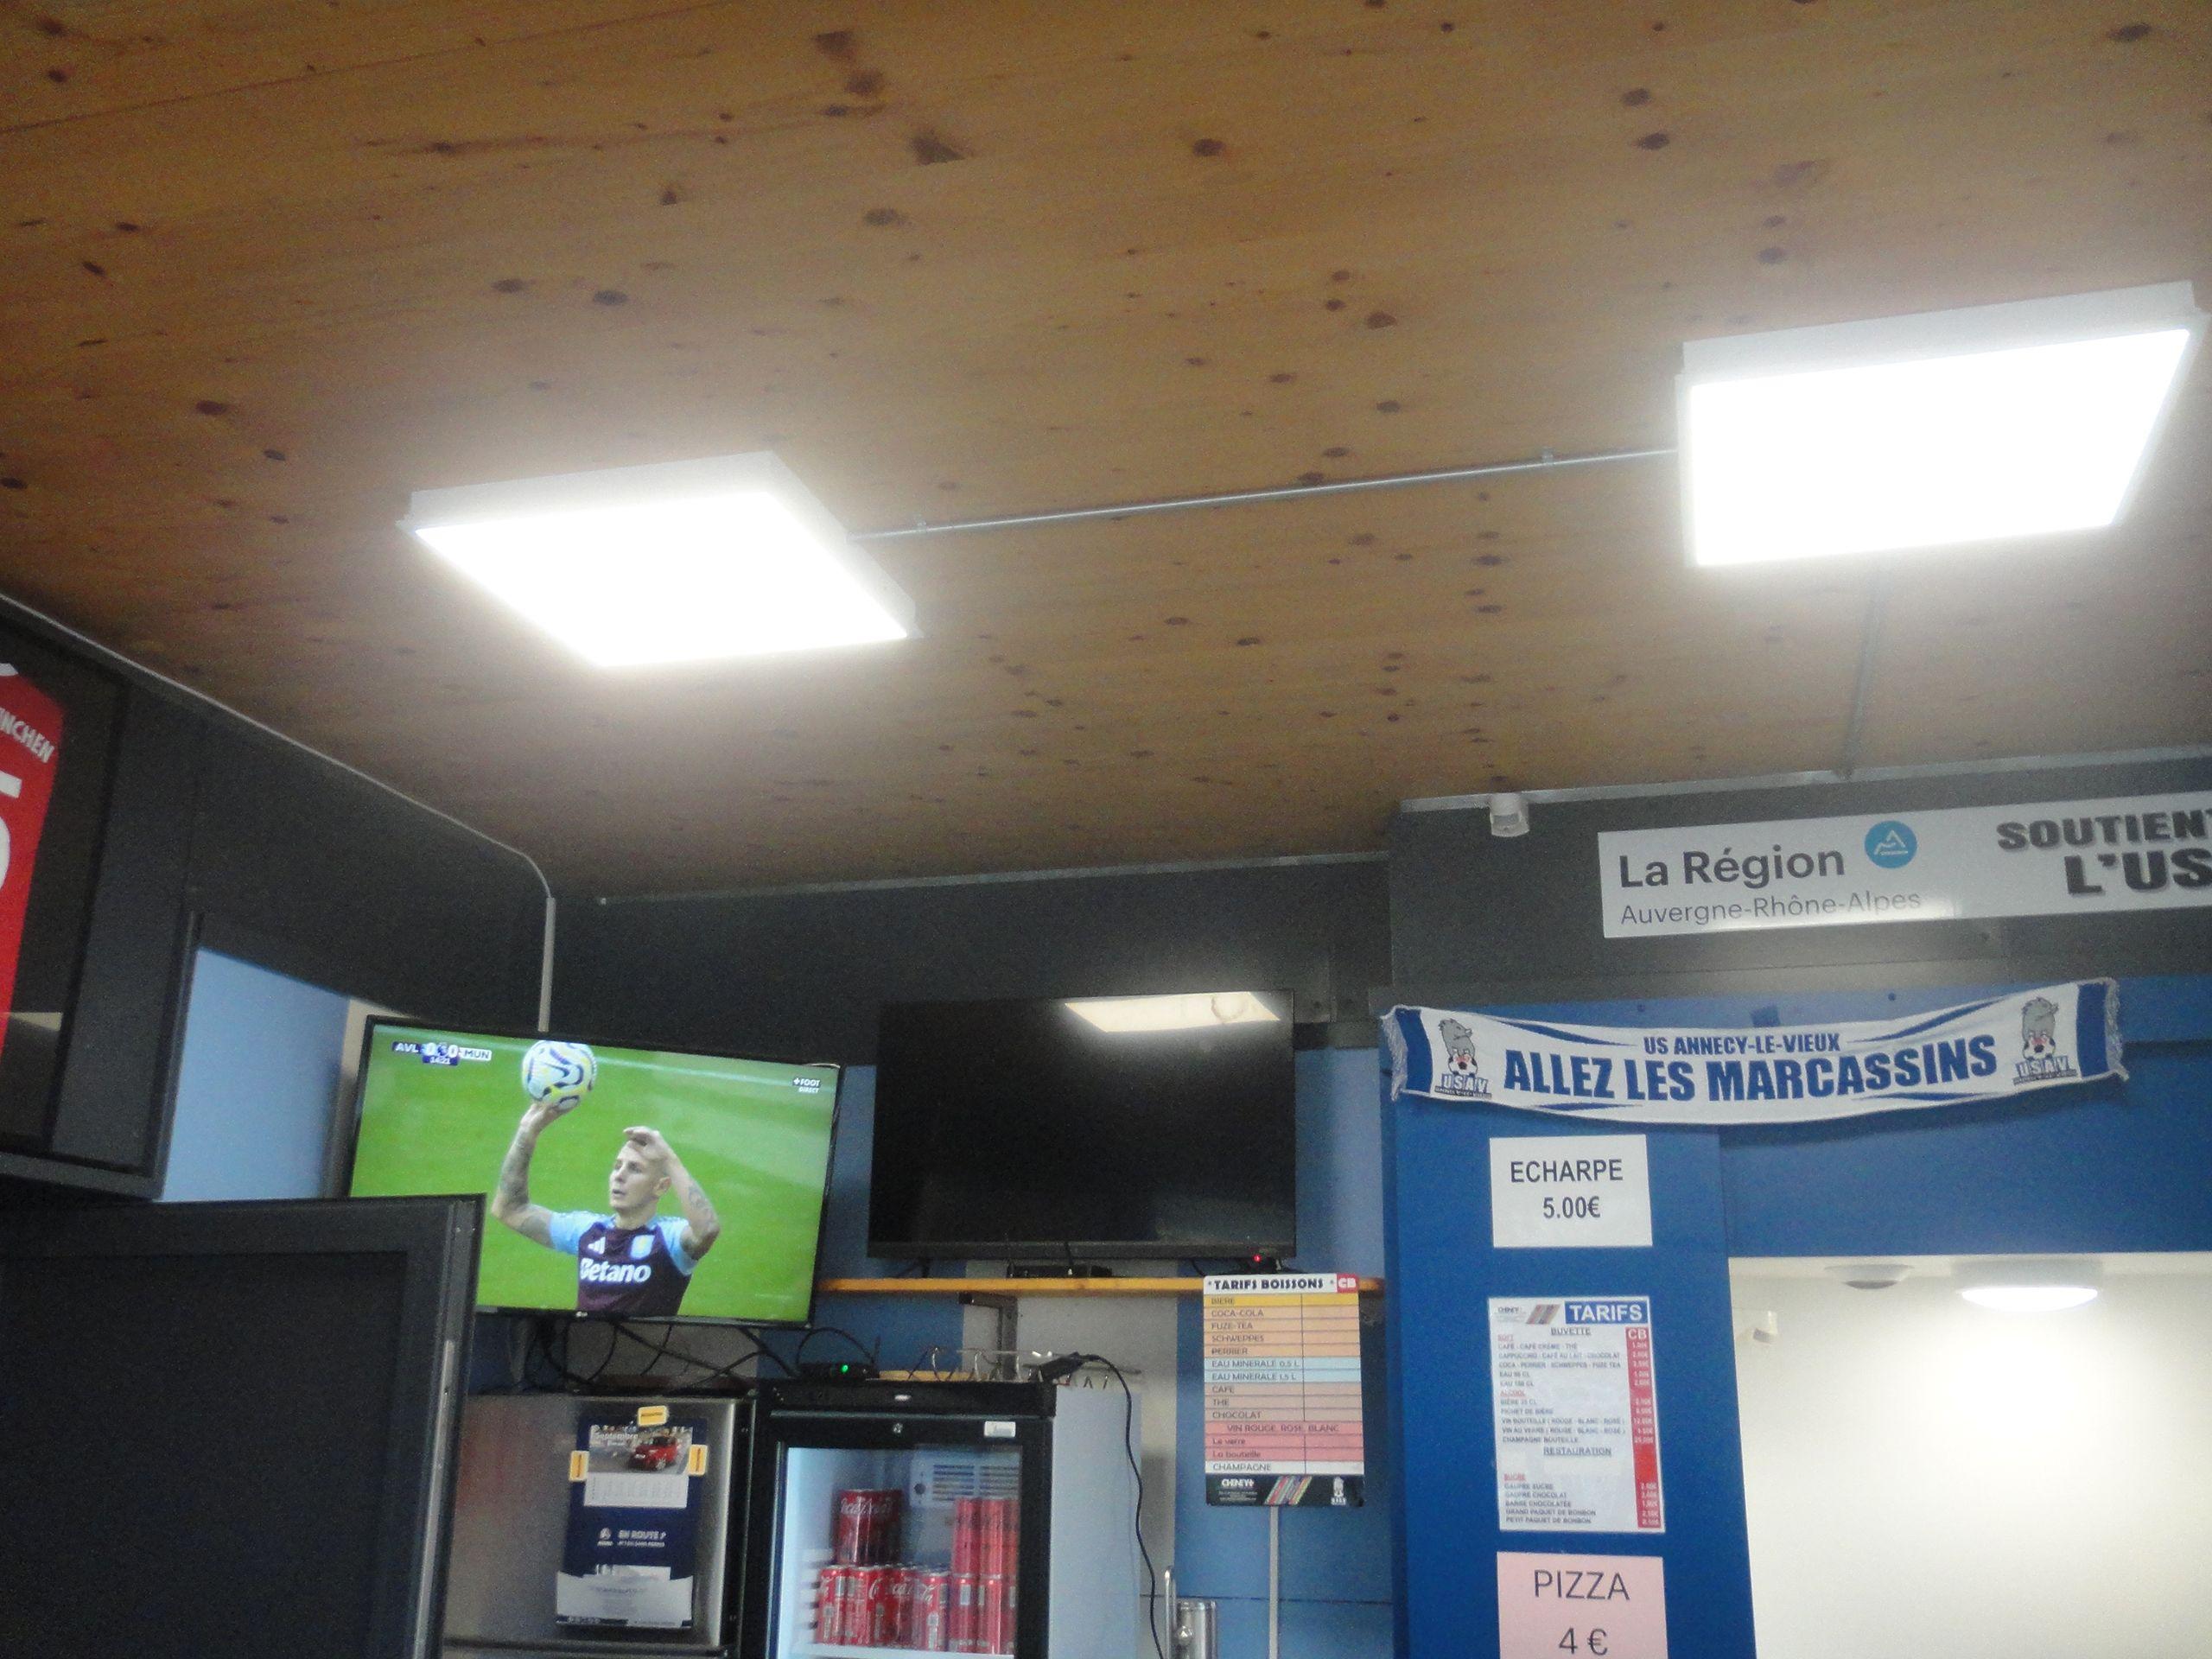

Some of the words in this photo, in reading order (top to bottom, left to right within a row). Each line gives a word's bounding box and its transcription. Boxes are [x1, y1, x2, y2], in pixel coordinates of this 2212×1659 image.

[1996, 809, 2212, 850] SOUTIEN
[1619, 855, 1669, 887] La
[1683, 844, 1845, 889] Région
[2064, 848, 2212, 894] L'US
[1620, 891, 1922, 925] Auvergne-Rhône-Alpes
[396, 1042, 419, 1053] AVL
[464, 1048, 490, 1059] MUN
[1643, 1036, 1669, 1055] US
[1674, 1033, 1840, 1055] ANNECY-LE-VIEUX
[1504, 1049, 1615, 1099] ALLEZ
[1624, 1058, 1695, 1102] LES
[1706, 1034, 1998, 1102] MARCASSINS
[1510, 1159, 1623, 1183] ECHARPE
[1543, 1196, 1601, 1219] 5.00€
[1214, 1279, 1257, 1290] TARIFS
[1262, 1278, 1323, 1289] BOISSONS
[1570, 1305, 1643, 1321] TARIFS
[1628, 1330, 1647, 1339] CB
[1534, 1569, 1630, 1600] PIZZA
[1559, 1627, 1578, 1655] 4
[1586, 1628, 1608, 1656] €
